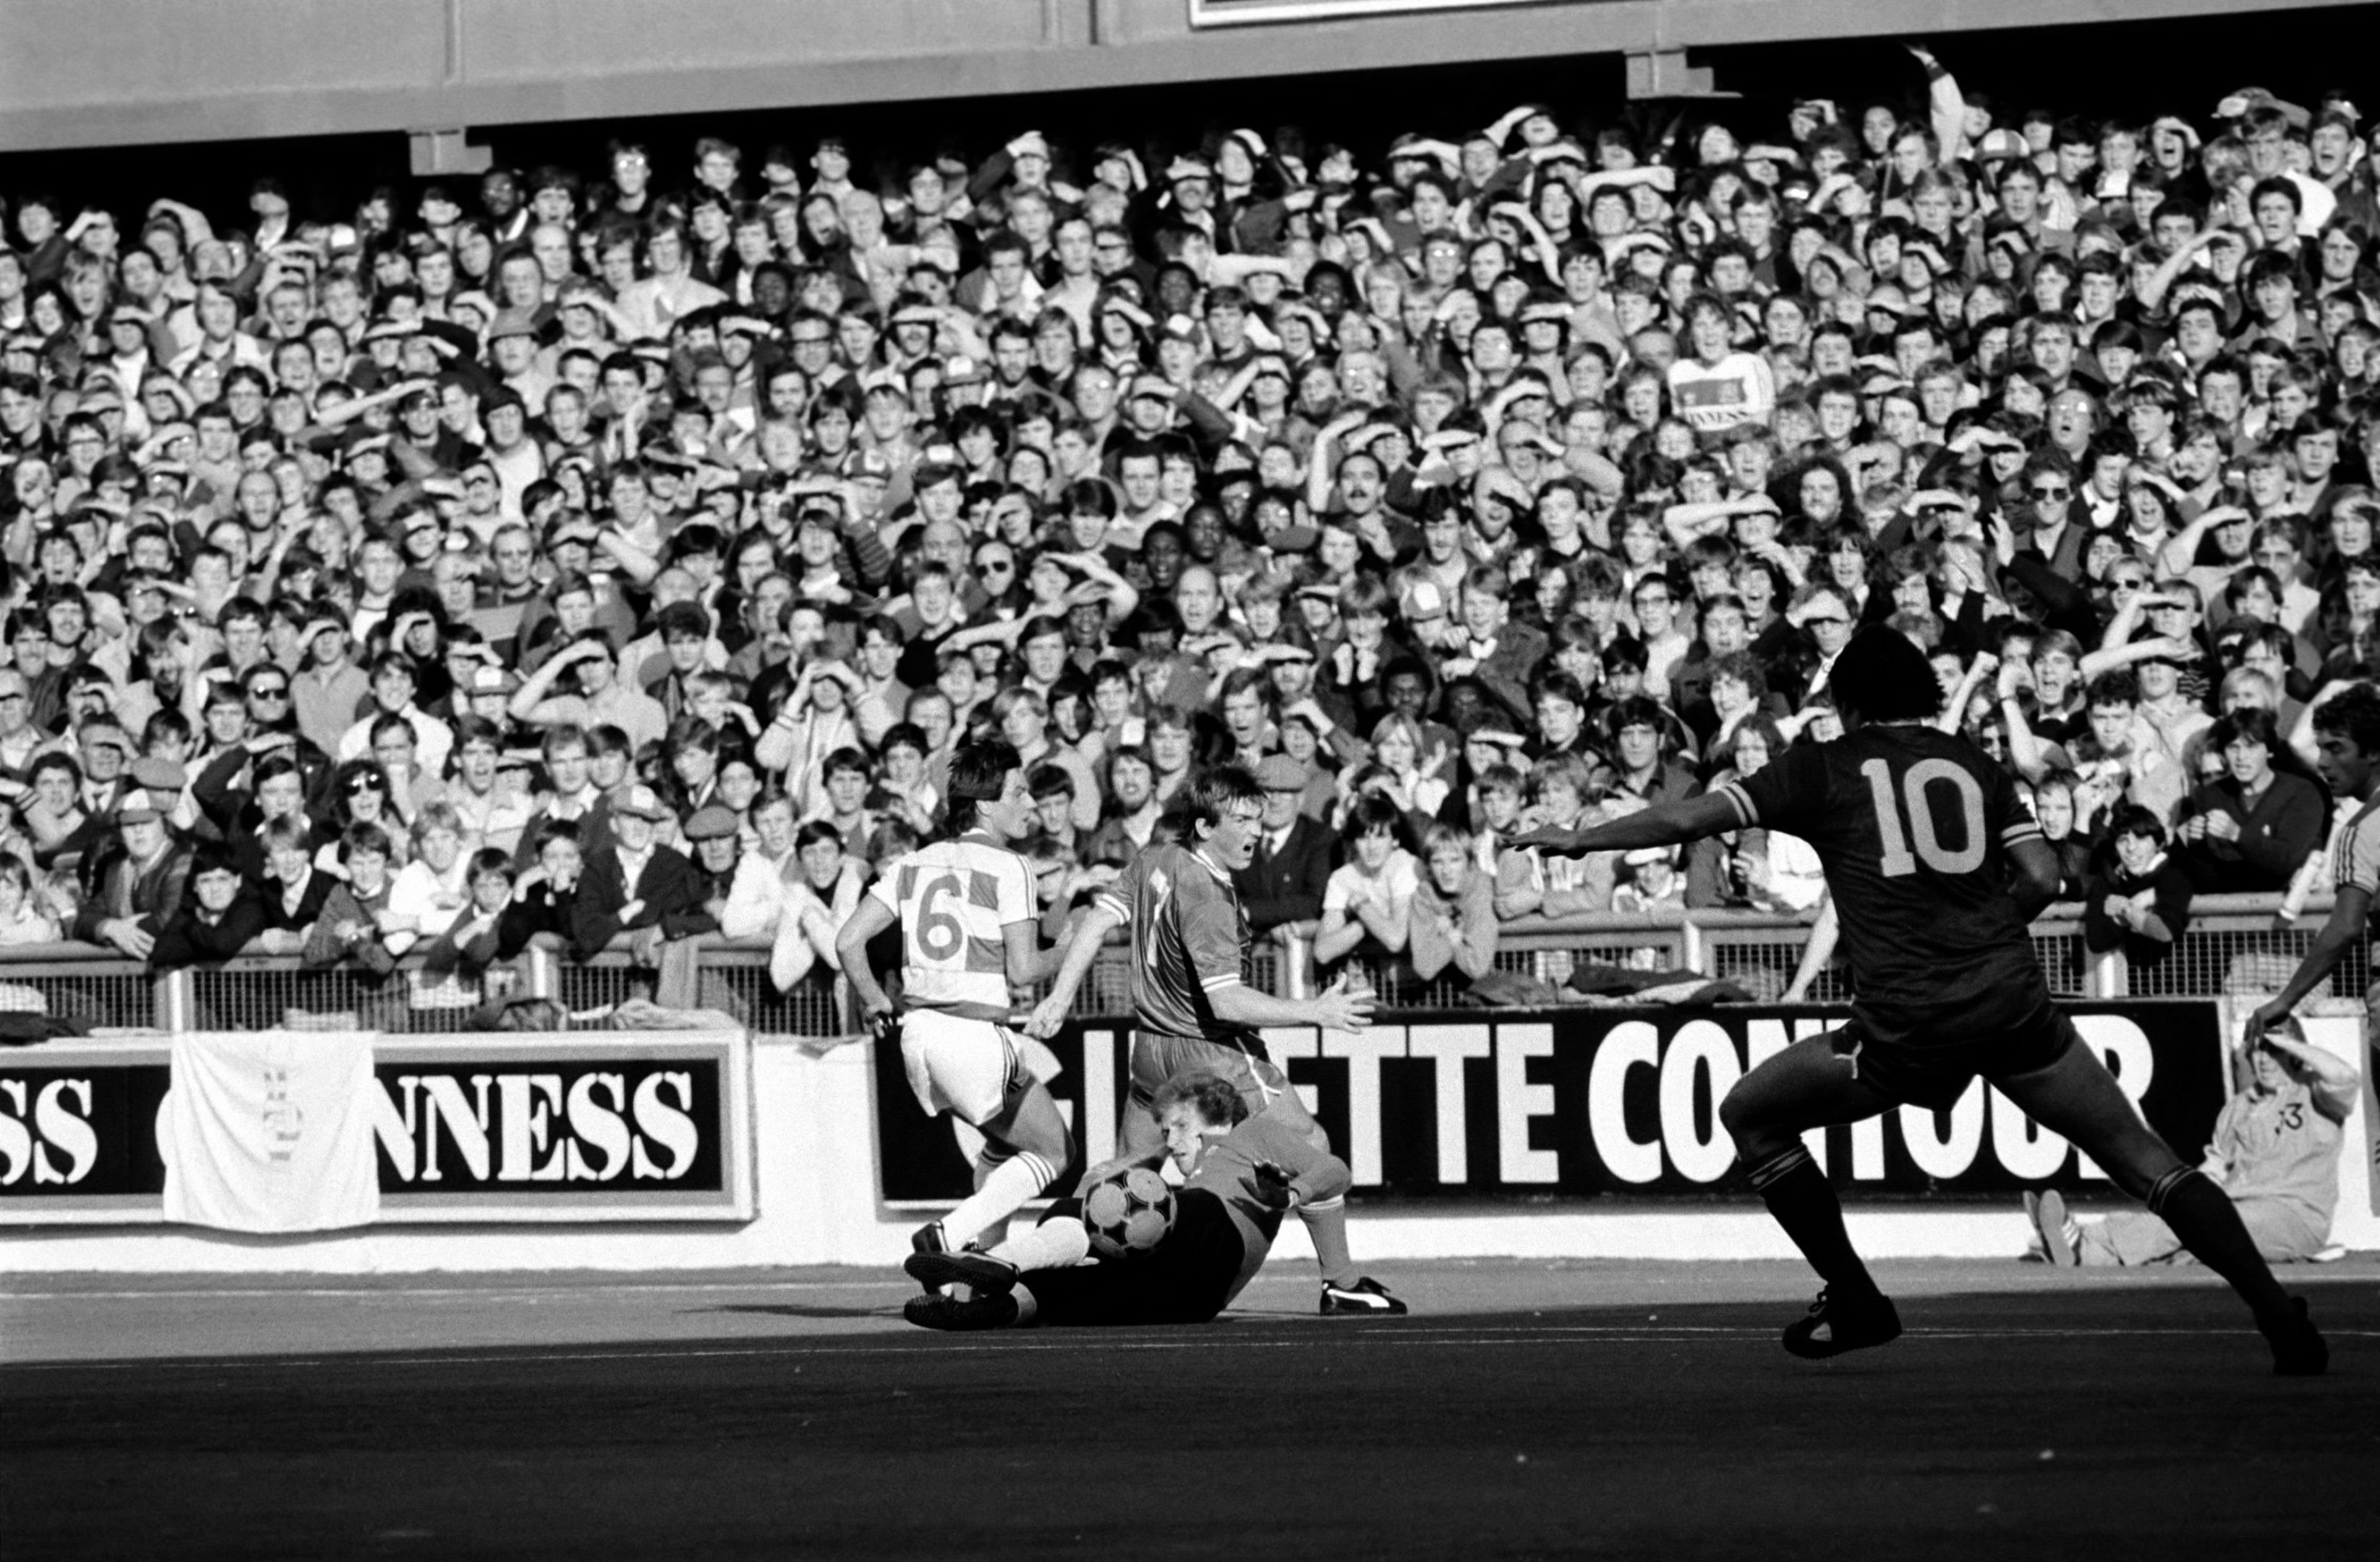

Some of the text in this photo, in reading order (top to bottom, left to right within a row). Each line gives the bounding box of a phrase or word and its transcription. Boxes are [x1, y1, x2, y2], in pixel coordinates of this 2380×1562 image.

[1861, 758, 1986, 876] 10
[916, 874, 963, 961] 6
[155, 1072, 699, 1181] NNESS
[951, 1023, 1560, 1187] IETTE
